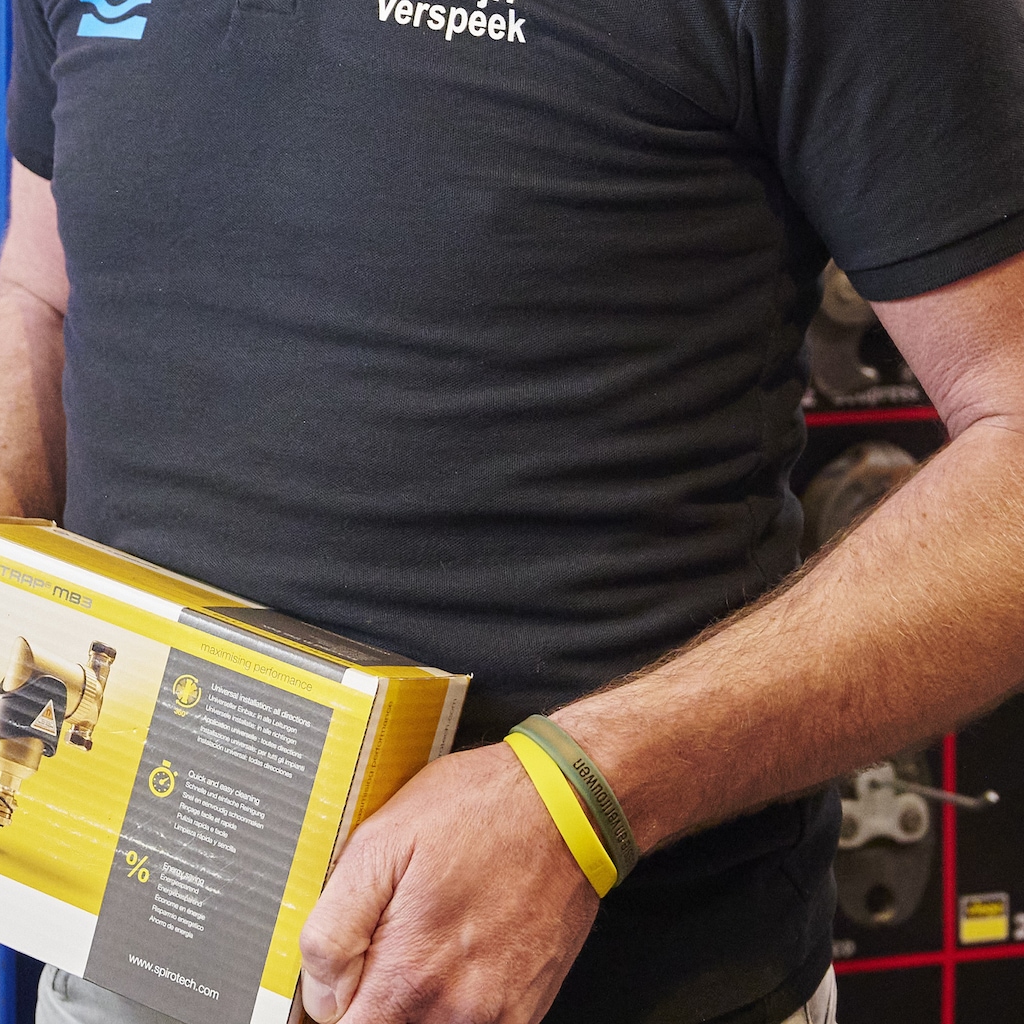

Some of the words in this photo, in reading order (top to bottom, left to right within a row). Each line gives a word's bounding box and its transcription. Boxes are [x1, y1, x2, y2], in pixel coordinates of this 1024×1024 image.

[200, 642, 252, 671] maximising
[253, 663, 313, 692] performance
[202, 715, 231, 731] Application
[211, 683, 239, 699] Universal
[281, 710, 311, 727] directions
[188, 770, 207, 783] Quick
[206, 778, 219, 788] and
[219, 784, 234, 795] easy
[235, 790, 260, 806] cleaning
[572, 757, 622, 830] vertrouwen
[128, 953, 220, 1001] www.spirotech.com
